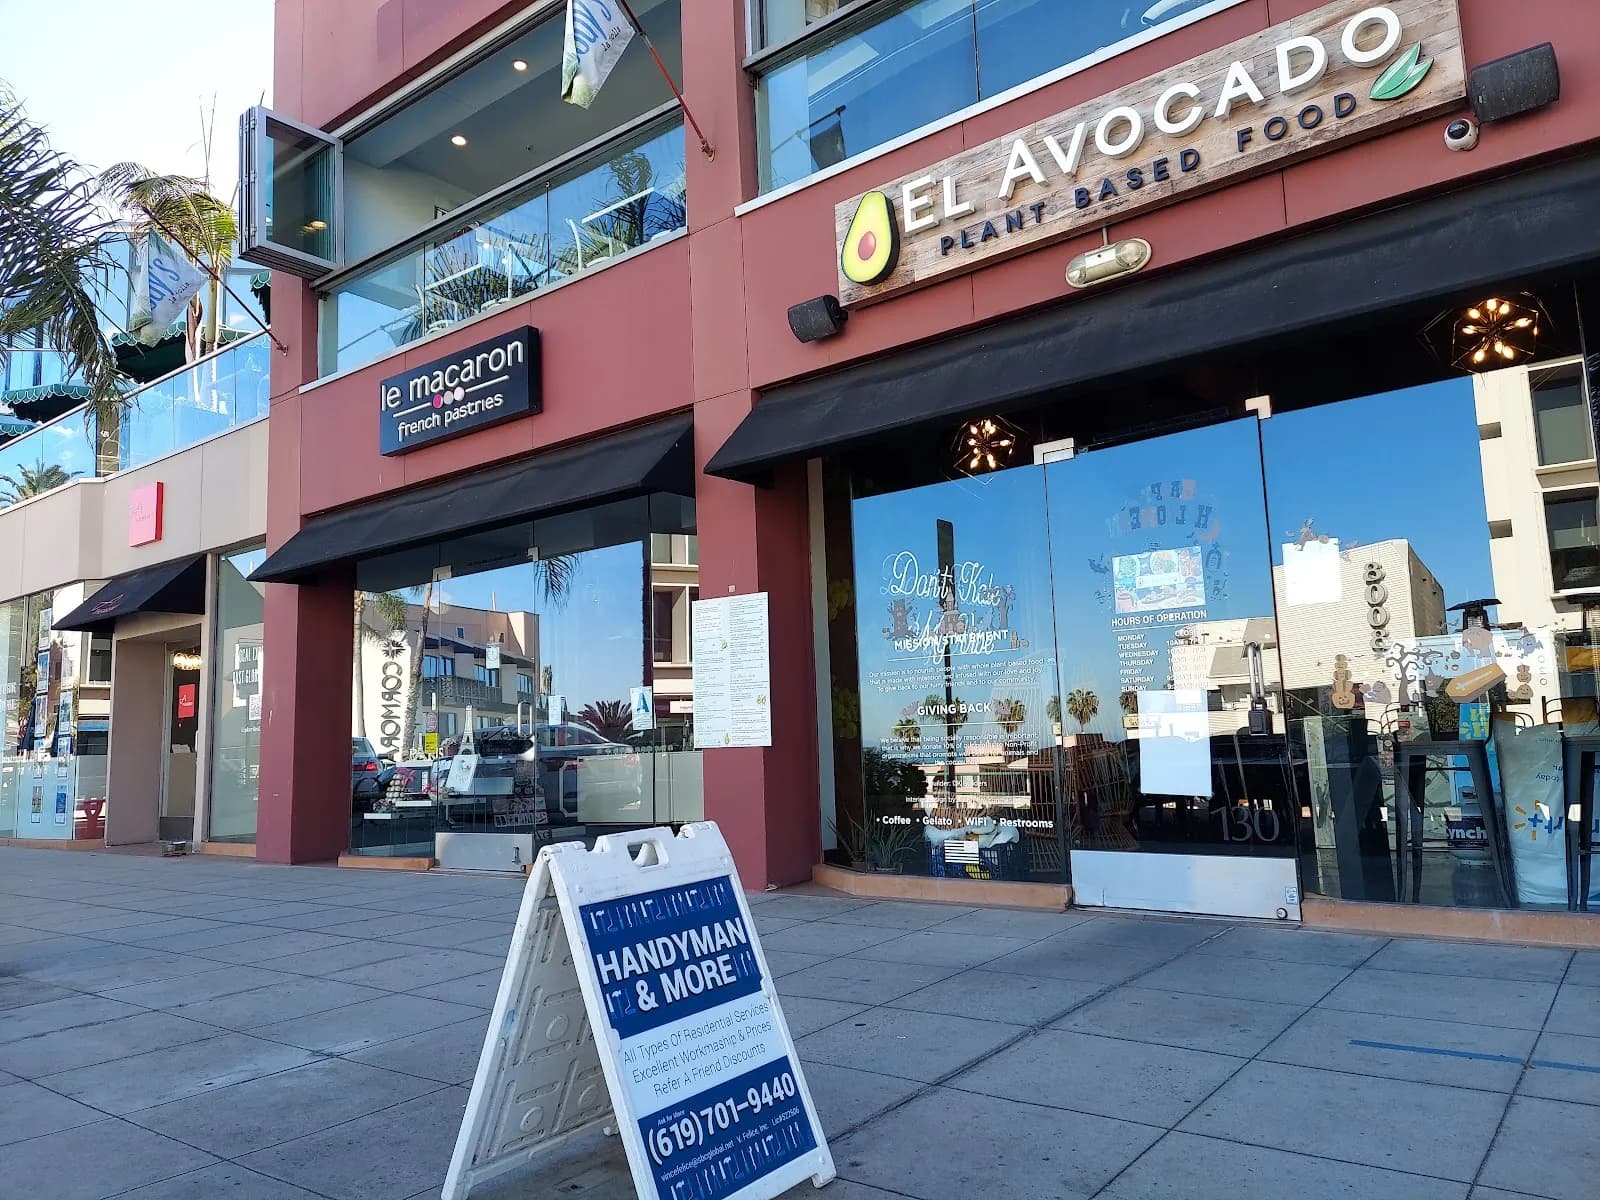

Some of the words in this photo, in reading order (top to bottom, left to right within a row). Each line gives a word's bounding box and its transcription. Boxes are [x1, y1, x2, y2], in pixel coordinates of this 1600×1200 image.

[902, 174, 975, 233] EL
[998, 6, 1402, 201] AVOCADO
[940, 202, 1045, 256] PLANT
[1074, 148, 1200, 209] BASED
[1236, 92, 1357, 152] FOOD
[381, 384, 401, 411] le
[409, 340, 524, 401] macaron
[398, 412, 441, 442] french
[444, 394, 504, 427] pastries
[1111, 617, 1141, 627] HOURS
[1142, 615, 1155, 624] OF
[1156, 610, 1208, 623] OPERATION
[1117, 633, 1145, 642] MONDAY
[1118, 642, 1148, 650] TUESDAY
[1118, 650, 1159, 658] WEDNESDAY
[1119, 659, 1154, 667] THURSDAY
[1119, 668, 1143, 676] FRIDAY
[1120, 676, 1155, 684] SATURDAY
[636, 692, 650, 713] A
[917, 704, 957, 715] GIVING
[959, 702, 992, 714] BACK
[882, 815, 912, 825] Coffee
[922, 815, 953, 826] Gelato
[1000, 817, 1054, 829] Restrooms
[1210, 805, 1280, 841] 130
[596, 917, 747, 985] HANDYMAN
[635, 979, 659, 1012] &
[659, 954, 737, 1004] MORE
[624, 1049, 637, 1065] All
[637, 1039, 669, 1061] Types
[670, 1030, 682, 1047] Of
[683, 1013, 734, 1042] Residential
[734, 1001, 769, 1023] Services
[632, 1055, 680, 1085] Excellent
[680, 1033, 737, 1064] Workmaship
[737, 1029, 745, 1042] &
[745, 1020, 772, 1039] Prices
[653, 1077, 681, 1098] Refer
[684, 1071, 692, 1085] A
[692, 1058, 722, 1083] Friend
[722, 1042, 766, 1070] Discounts
